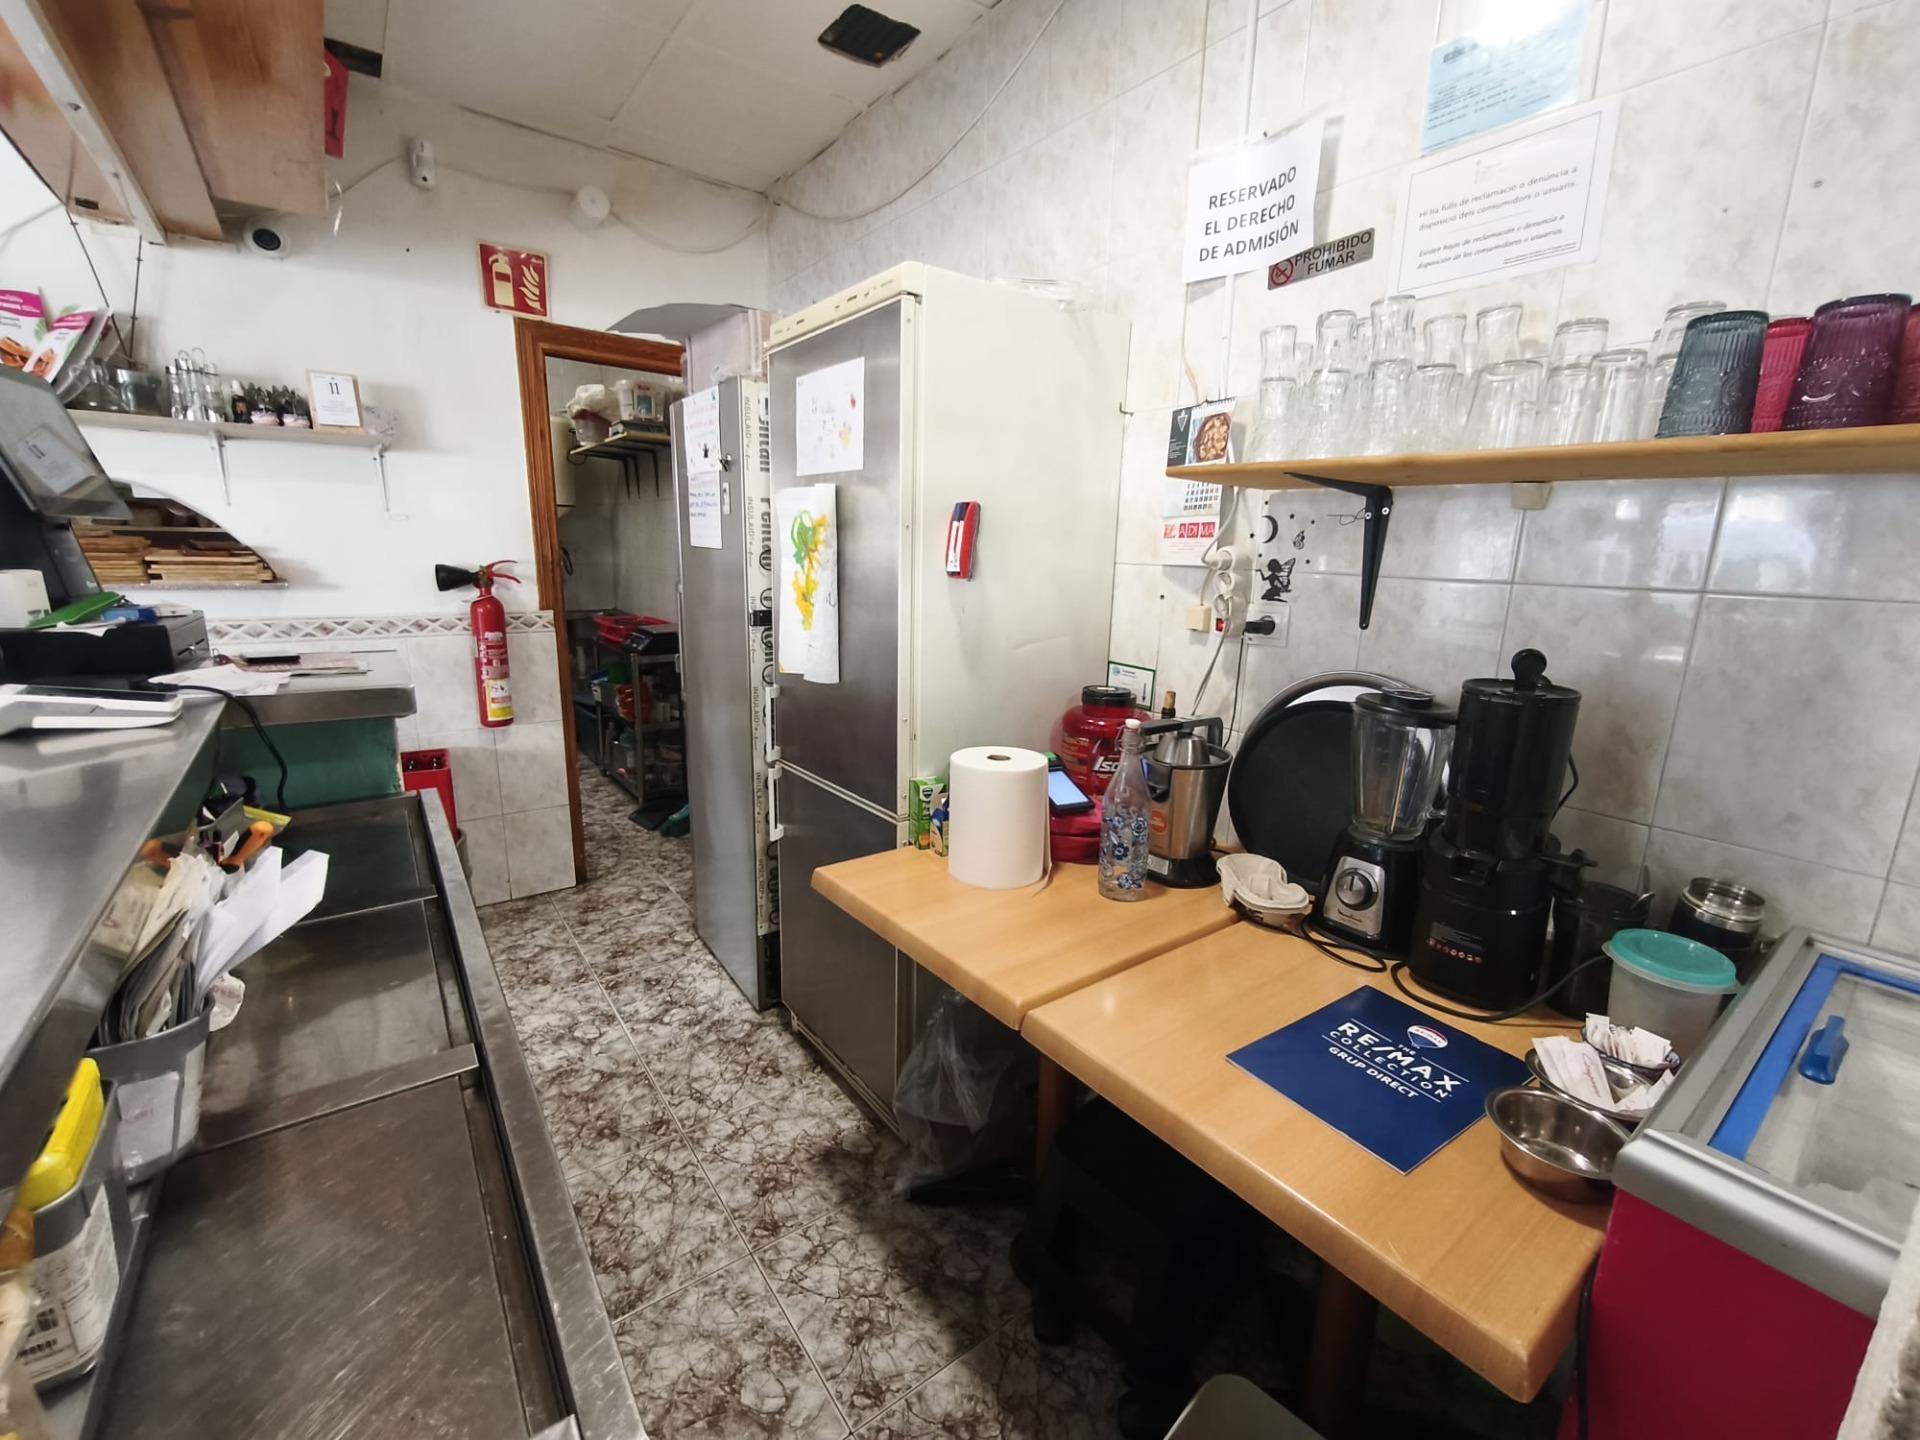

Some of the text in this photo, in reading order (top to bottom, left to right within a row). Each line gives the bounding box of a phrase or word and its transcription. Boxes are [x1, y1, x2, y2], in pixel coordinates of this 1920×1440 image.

[1208, 166, 1297, 210] RESERVADO
[1204, 194, 1296, 236] EL DERECHO
[1199, 218, 1300, 262] DE ADMISIÓN
[1294, 231, 1373, 267] PROHIBIDO
[1307, 250, 1356, 275] FUMAR
[1328, 1046, 1419, 1098] GRUP DIRECT
[1329, 1030, 1450, 1098] COLLECTION
[1337, 1022, 1462, 1092] RE/MAX
[1398, 1044, 1417, 1056] THE
